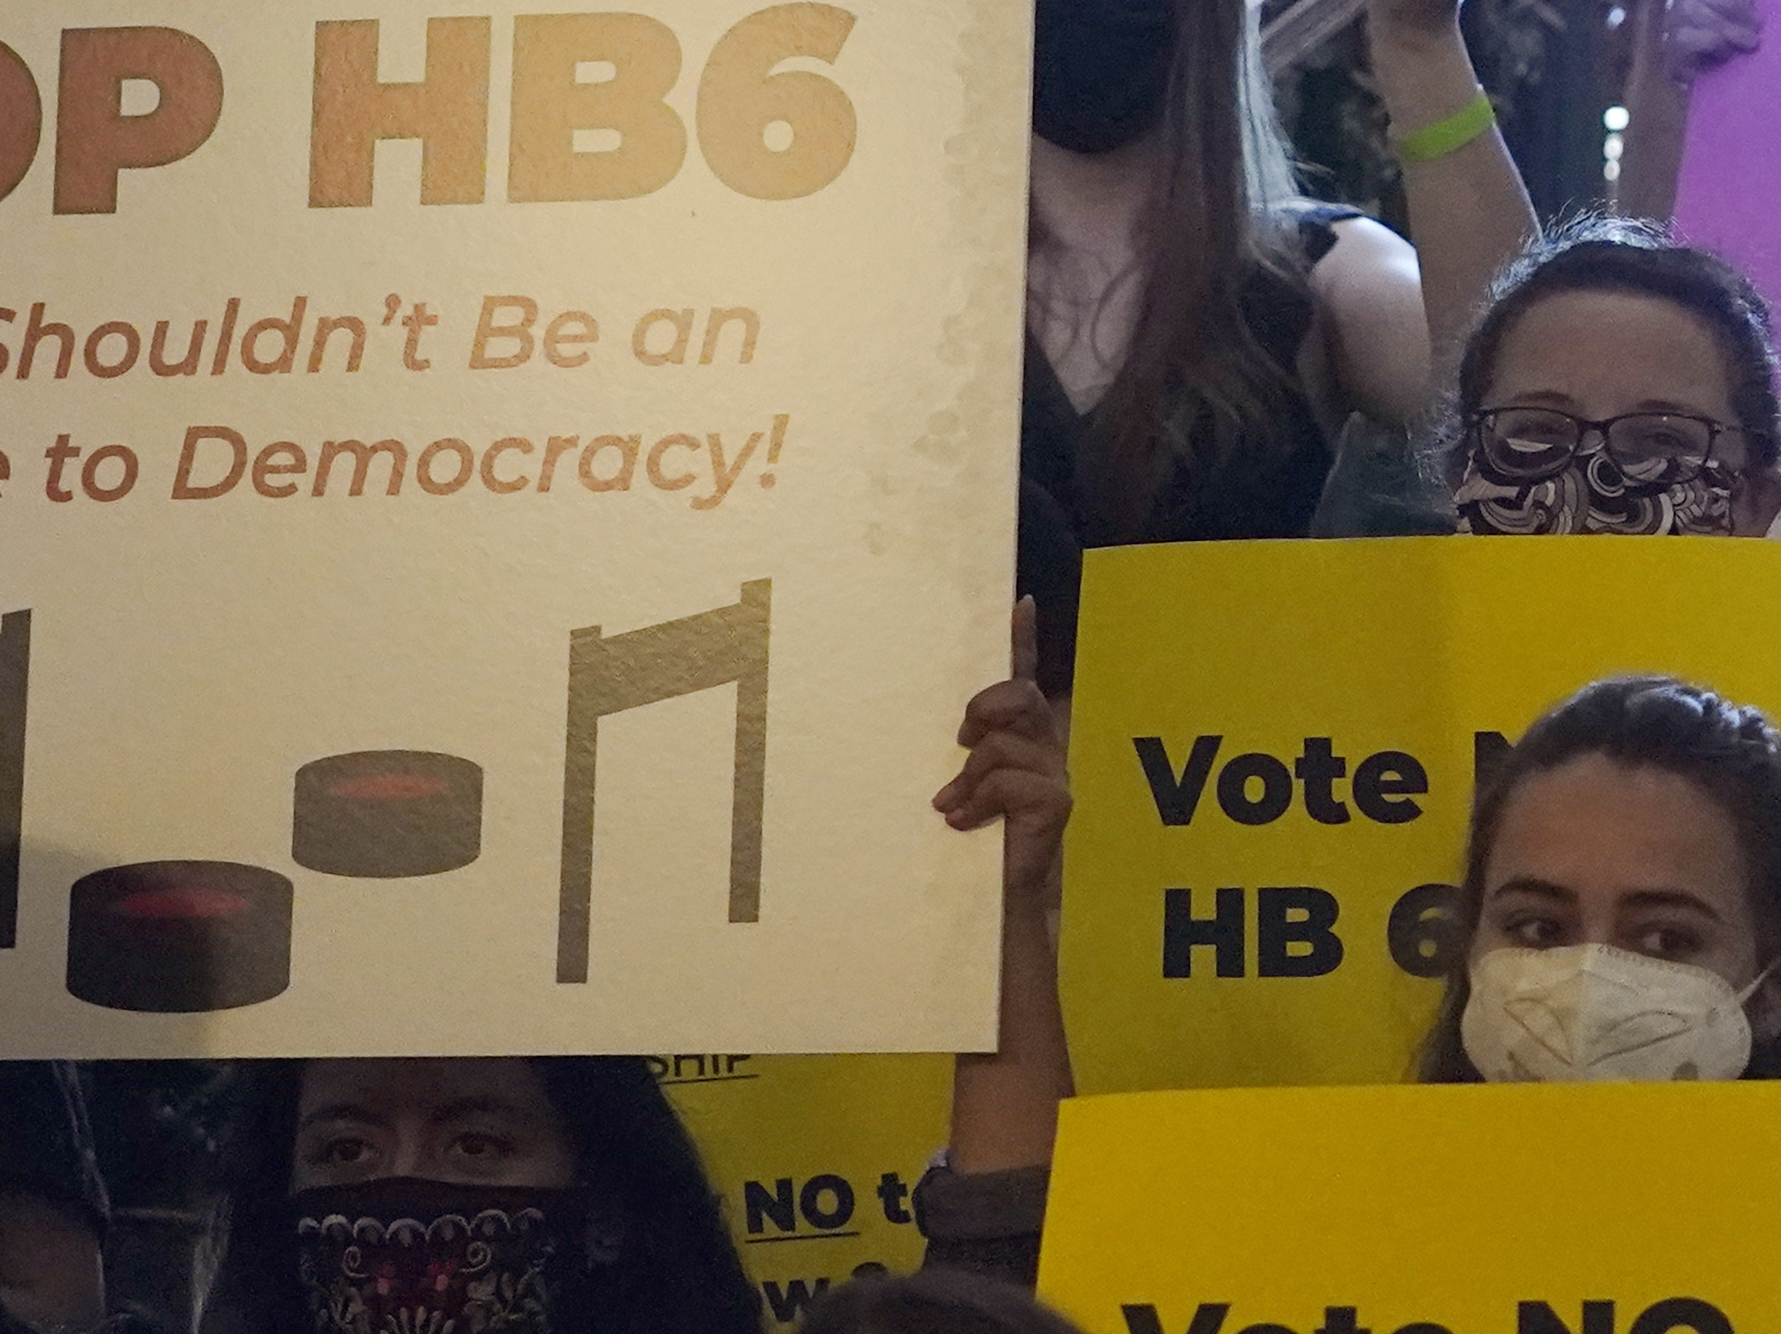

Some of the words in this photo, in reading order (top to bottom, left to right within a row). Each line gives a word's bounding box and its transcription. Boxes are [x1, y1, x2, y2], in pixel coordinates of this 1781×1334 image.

[308, 1, 860, 210] HB6
[467, 293, 600, 376] Be
[630, 300, 761, 370] an
[45, 432, 140, 504] to
[171, 414, 791, 512] Democracy!
[1134, 733, 1428, 828] Vote
[1162, 885, 1346, 980] HB
[744, 1174, 855, 1234] NO
